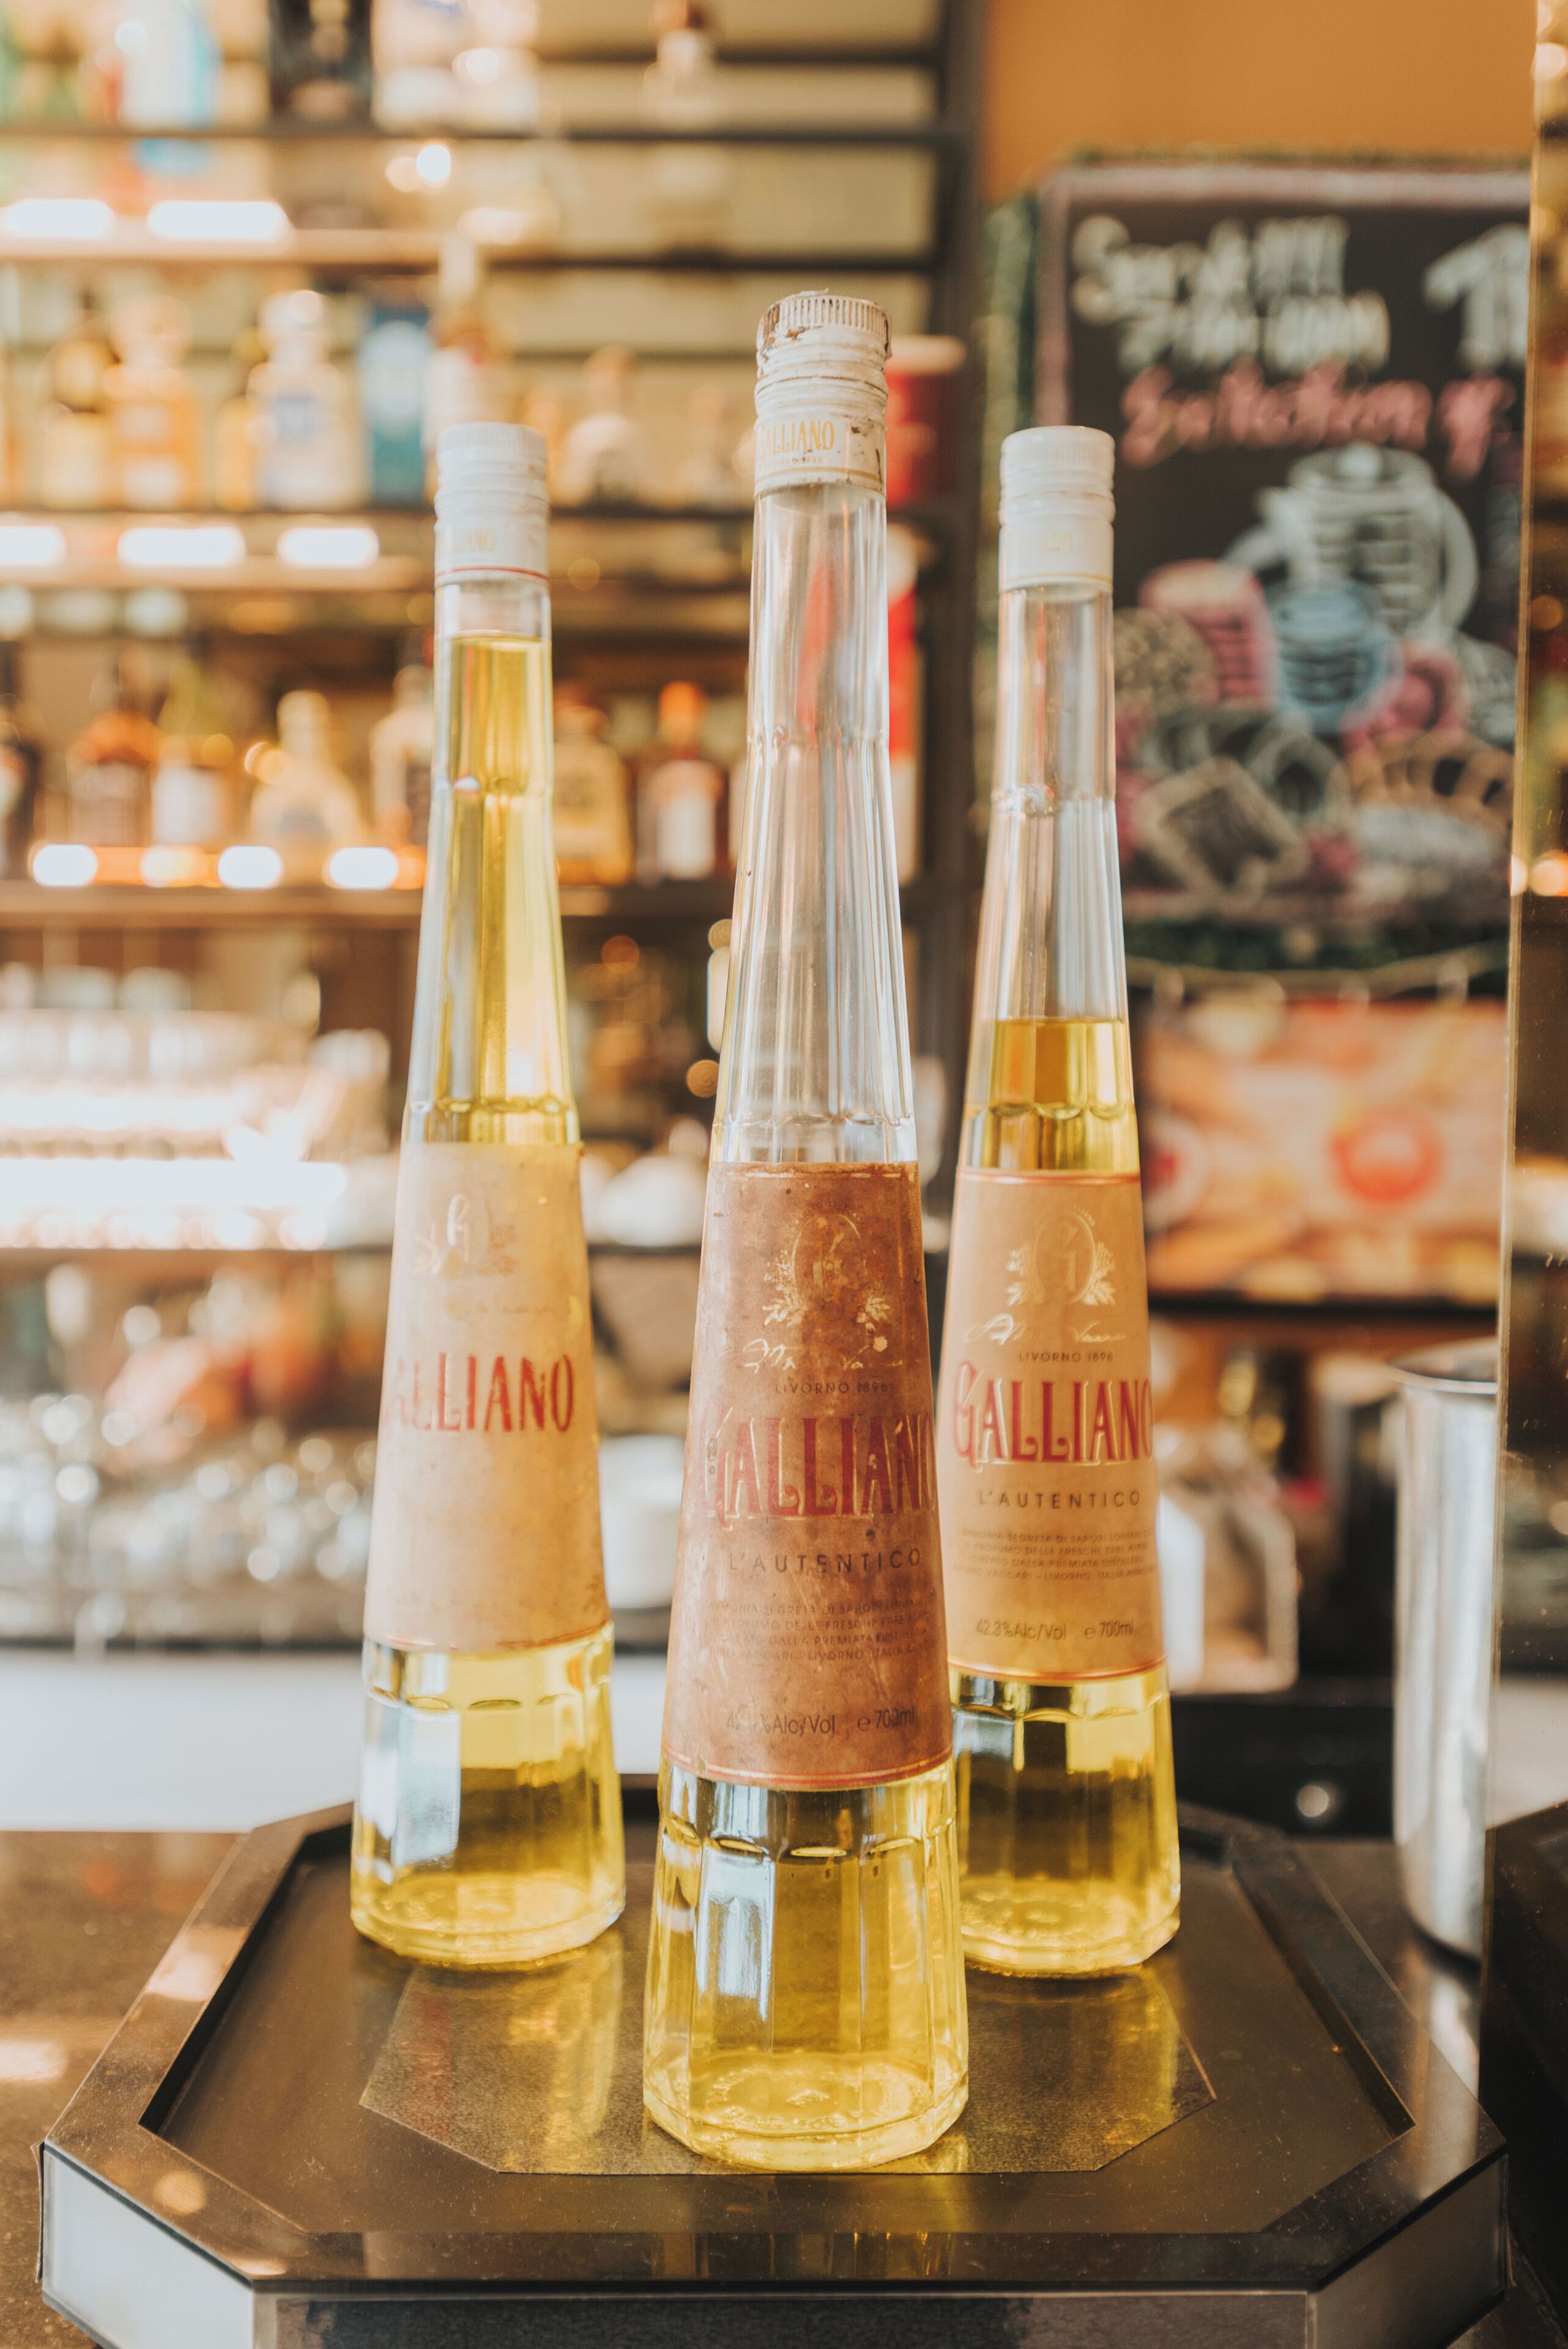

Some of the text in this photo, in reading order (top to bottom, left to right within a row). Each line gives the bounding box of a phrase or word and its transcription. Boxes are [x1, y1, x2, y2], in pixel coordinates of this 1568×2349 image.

[1019, 1351, 1113, 1362] LIVORNO 1896
[775, 1381, 850, 1395] LIVORNO
[953, 1360, 1154, 1471] GALLIANO
[979, 1490, 1140, 1510] L'AUTENTICO
[729, 1548, 921, 1573] L'AUTENTICO
